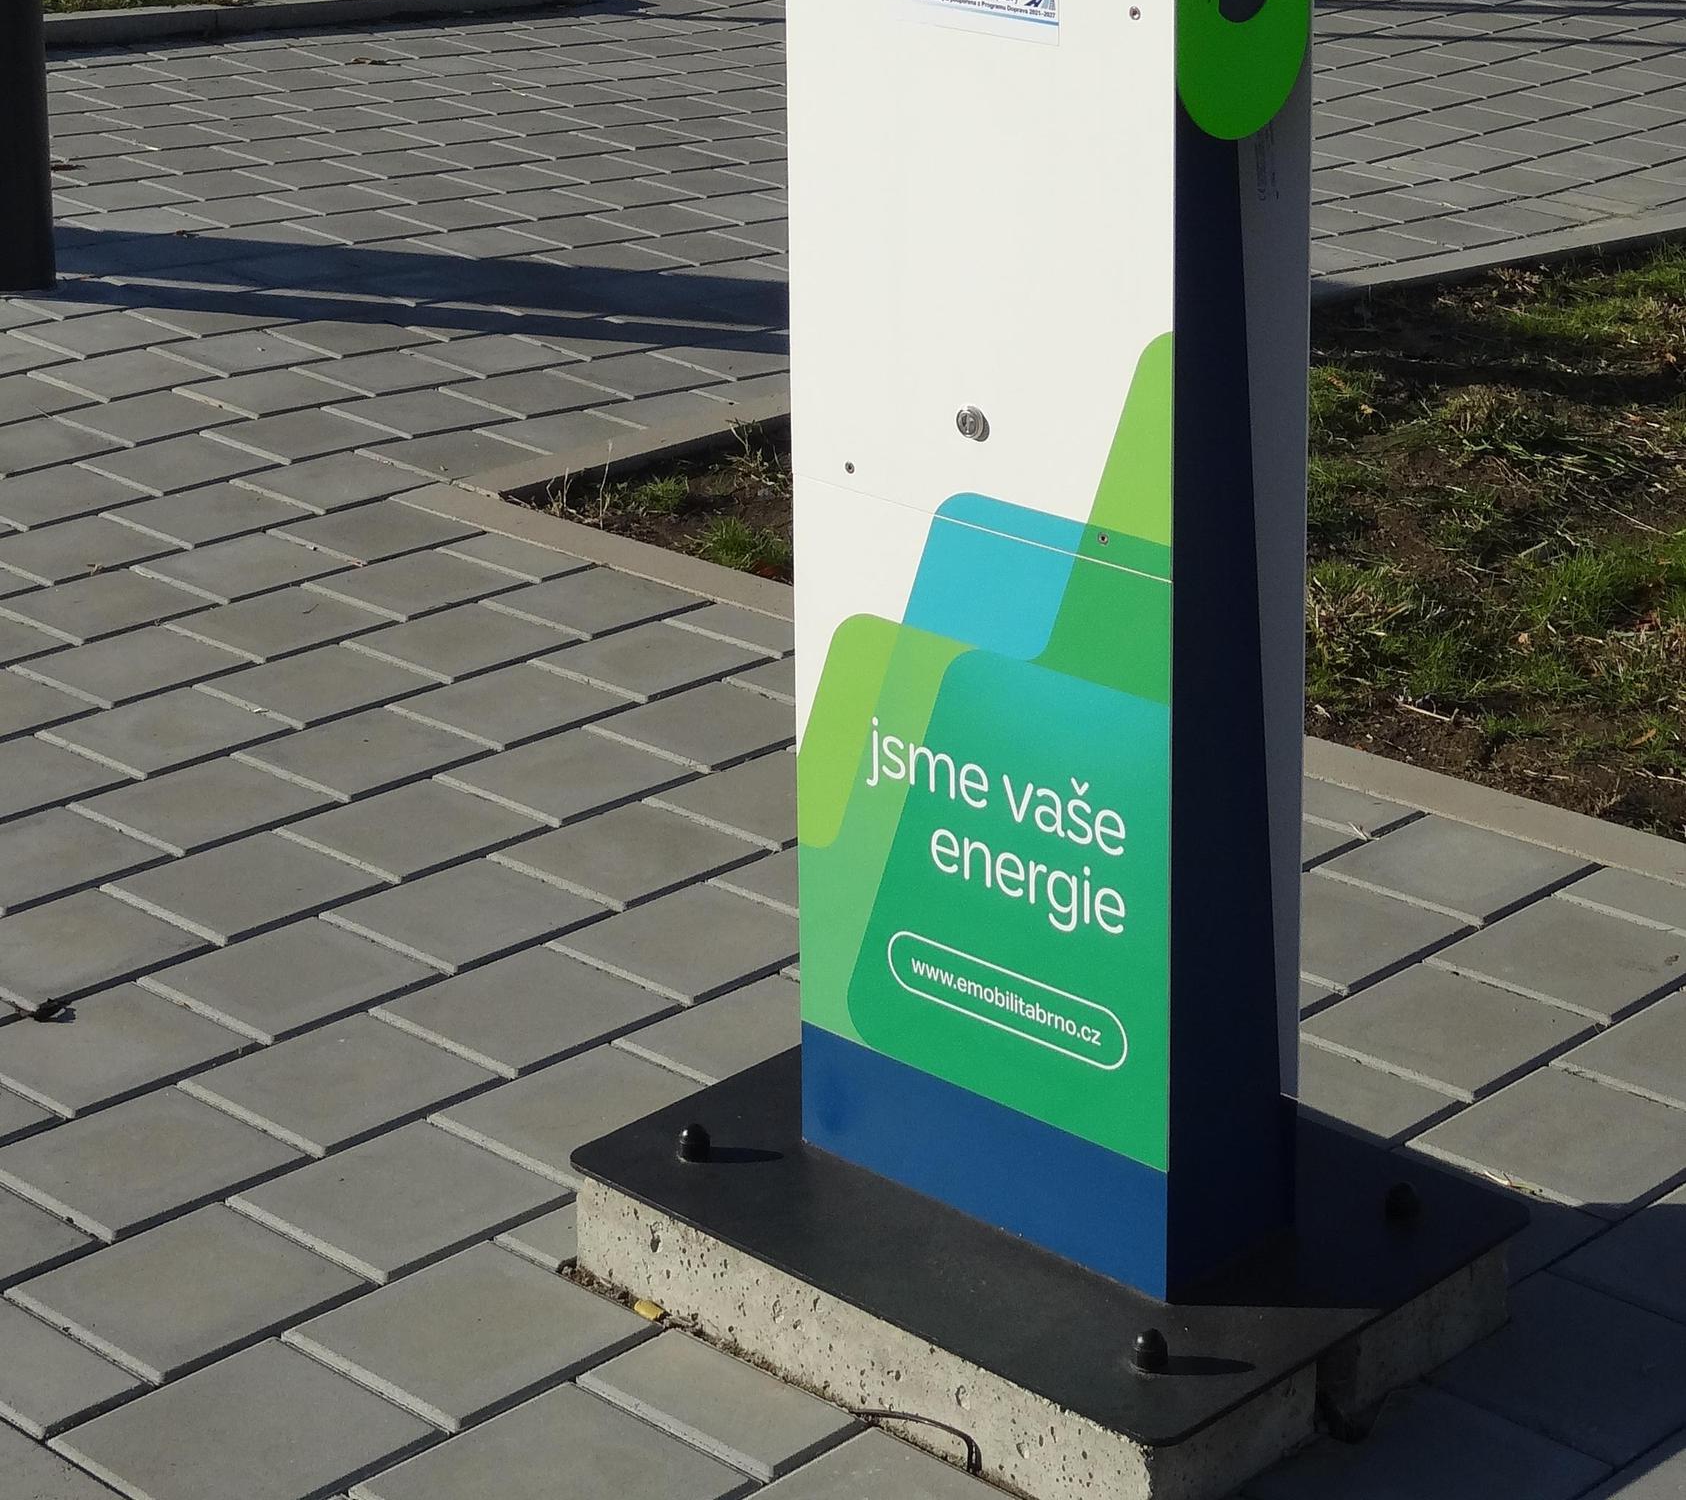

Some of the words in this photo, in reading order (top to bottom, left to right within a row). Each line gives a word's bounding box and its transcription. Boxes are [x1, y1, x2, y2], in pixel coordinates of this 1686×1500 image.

[982, 1, 1006, 10] Programu
[1007, 5, 1028, 14] Doprava
[866, 716, 989, 809] jsme
[1002, 776, 1126, 856] vaše
[930, 827, 1125, 934] energie
[911, 957, 1102, 1046] www.emobilitabrno.cz
